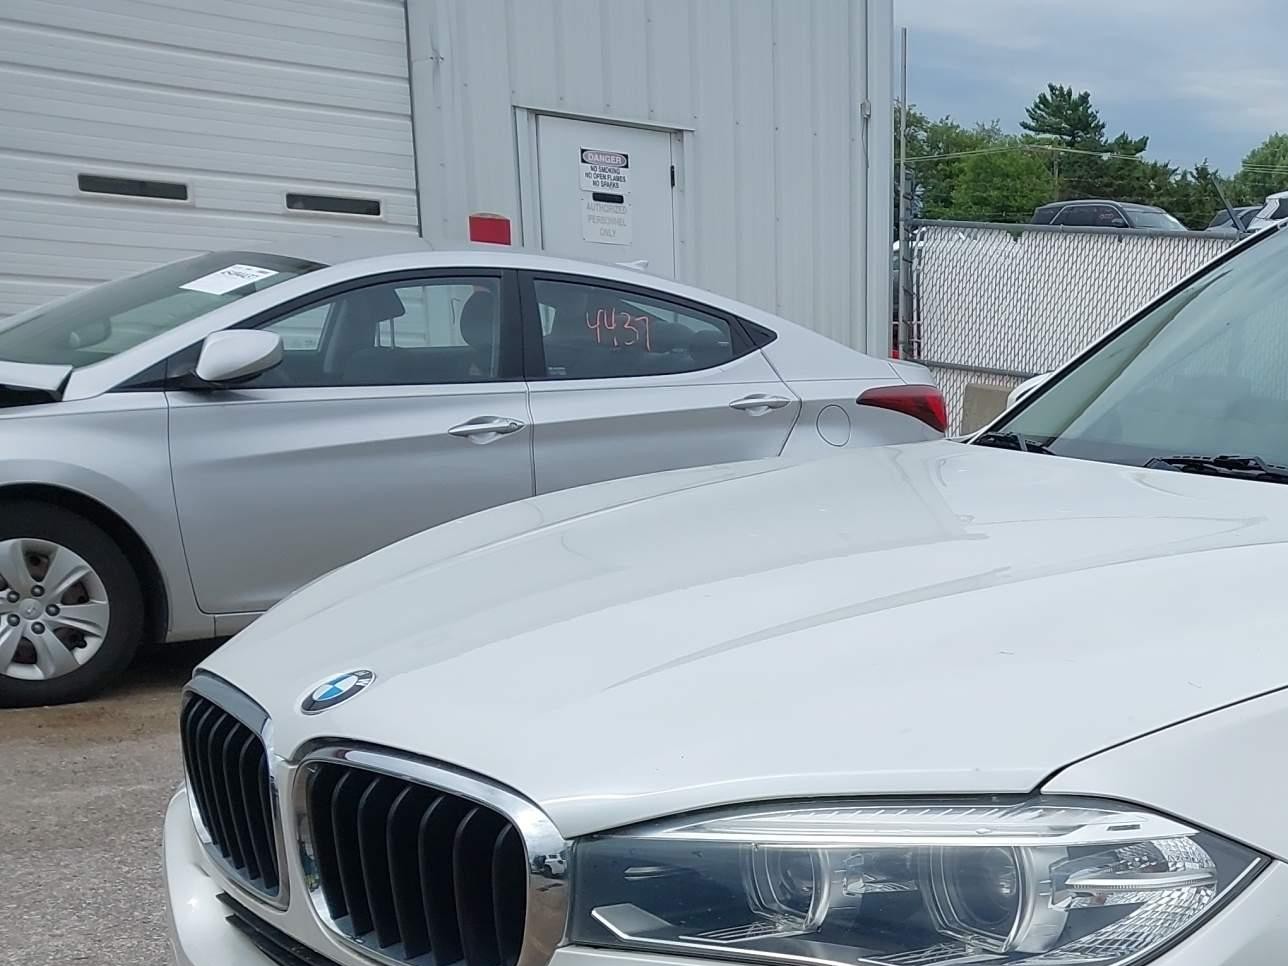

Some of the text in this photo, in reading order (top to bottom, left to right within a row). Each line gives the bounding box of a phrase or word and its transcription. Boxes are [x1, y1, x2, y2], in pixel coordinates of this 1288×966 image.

[588, 153, 622, 164] DANGER
[599, 166, 620, 174] SMOKING
[593, 172, 606, 180] OPEN
[607, 174, 626, 183] FLAMES
[600, 181, 620, 189] SPARKS
